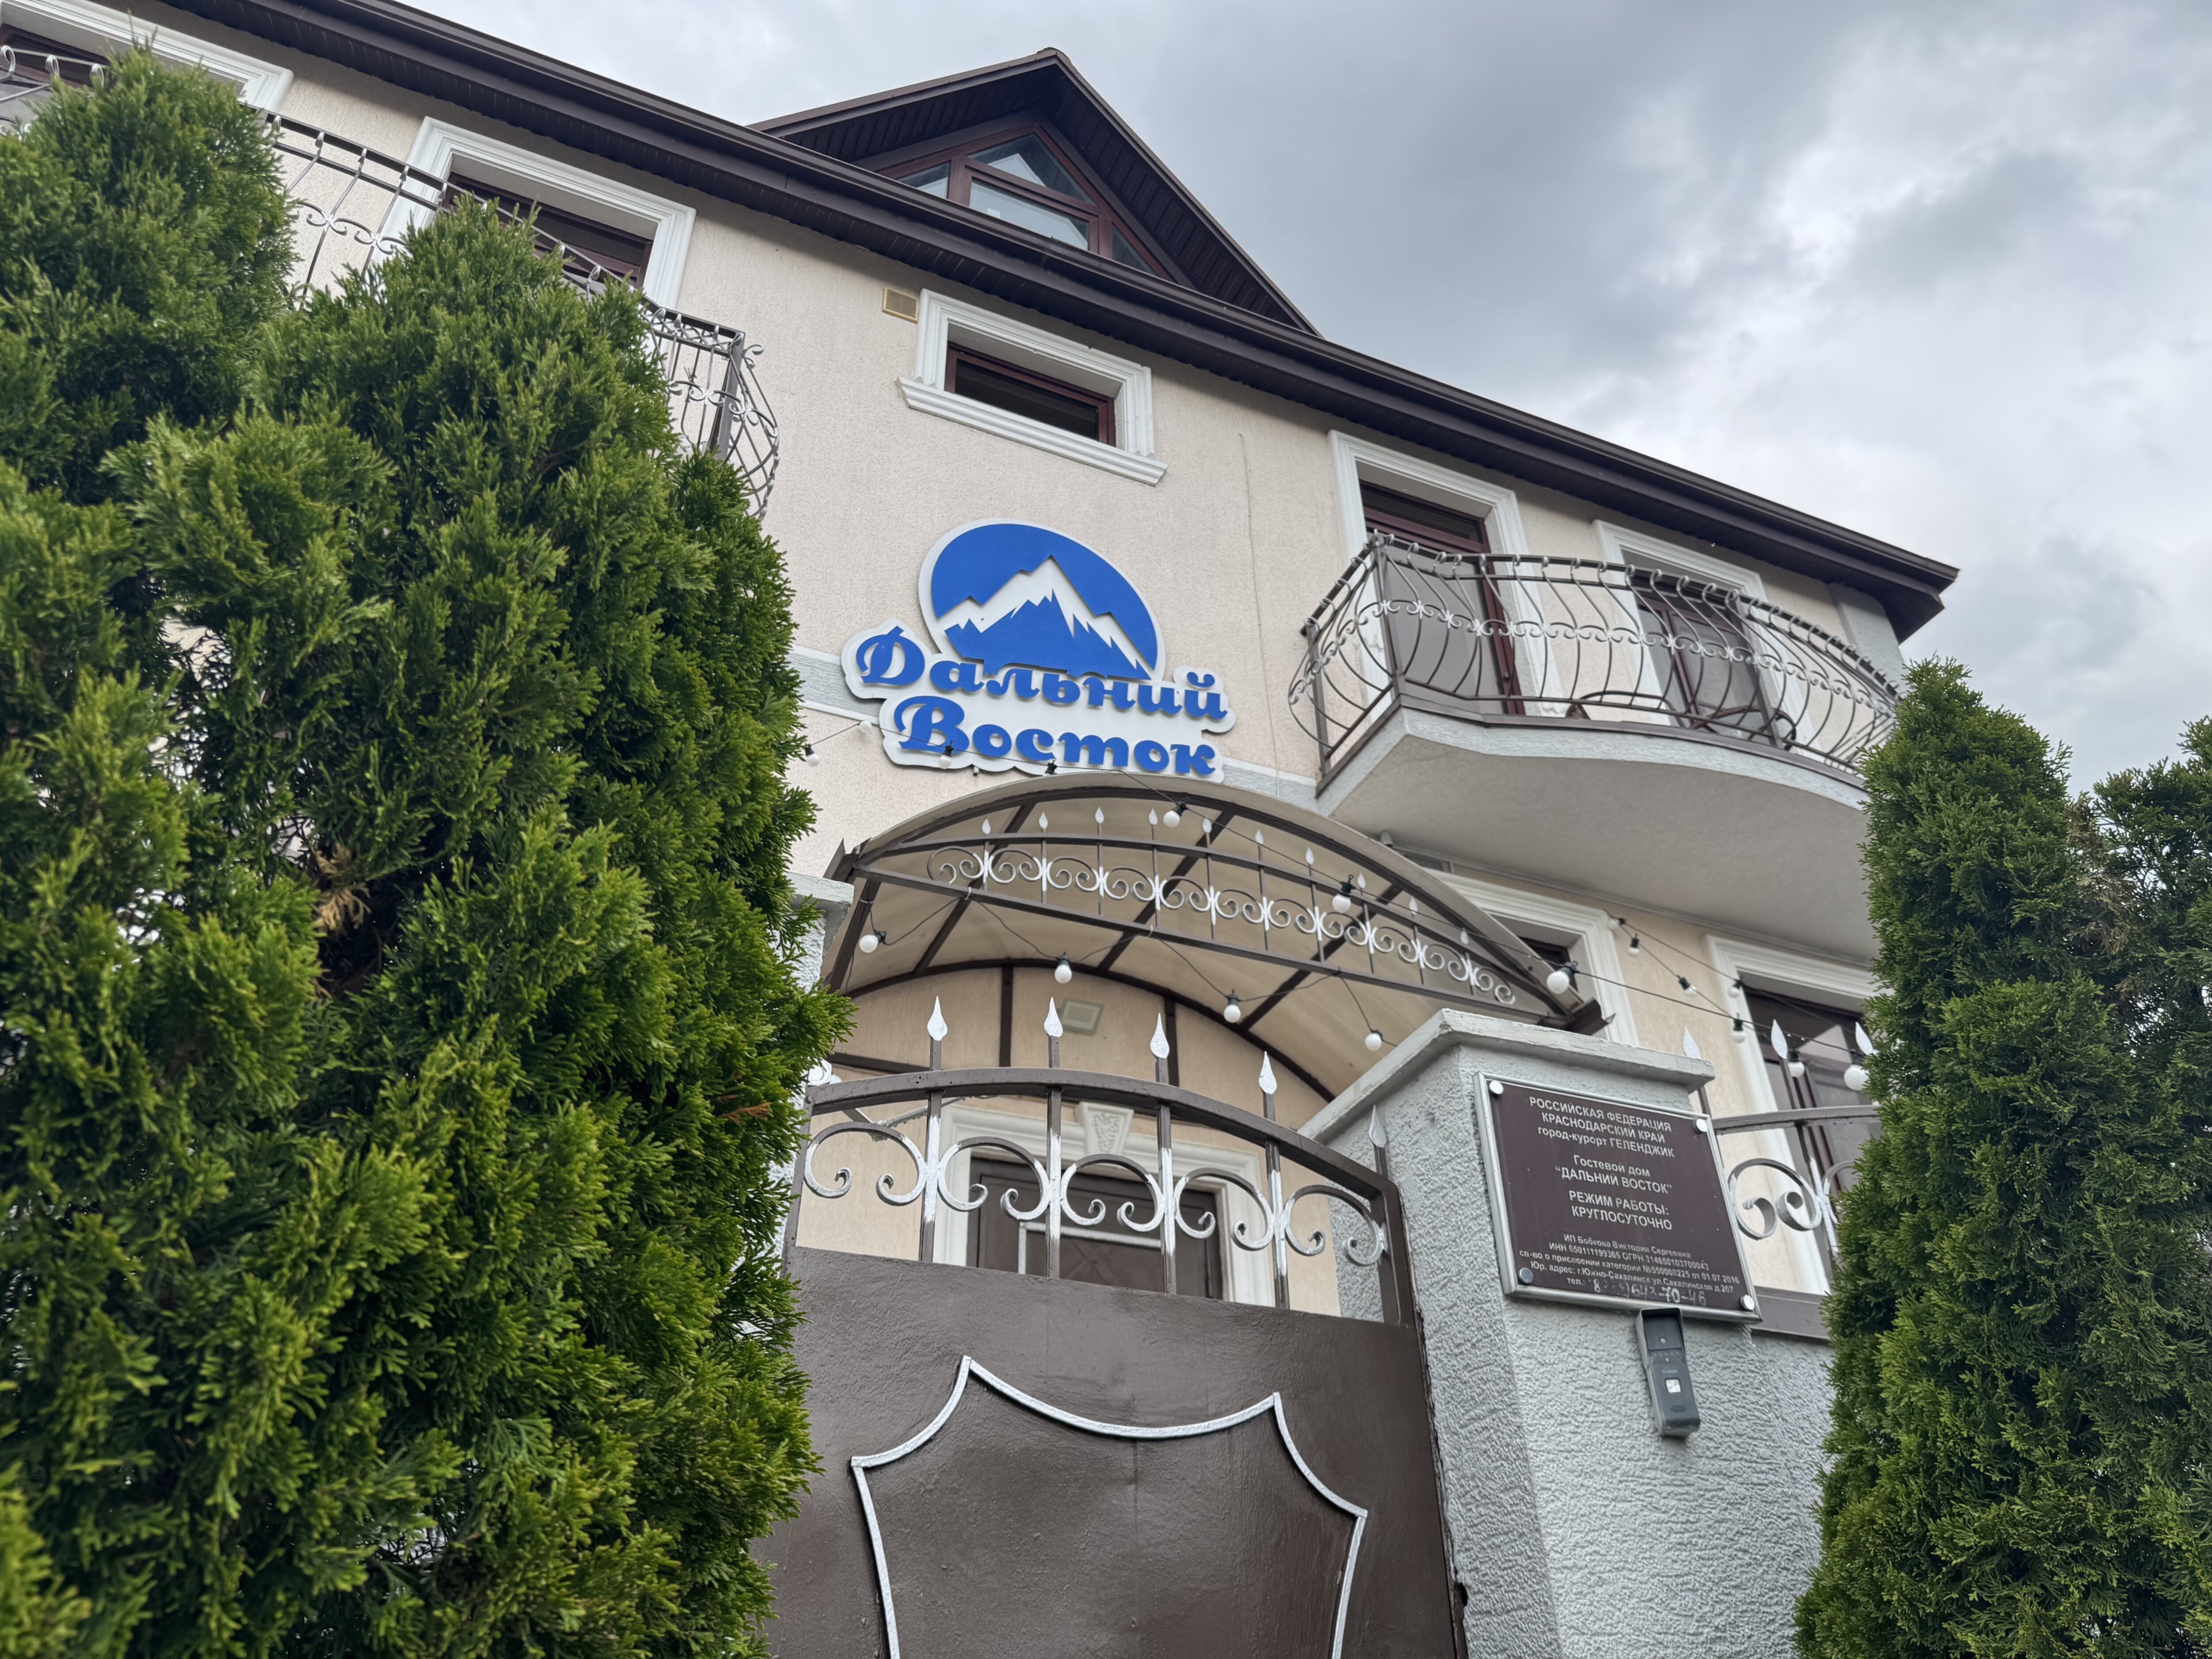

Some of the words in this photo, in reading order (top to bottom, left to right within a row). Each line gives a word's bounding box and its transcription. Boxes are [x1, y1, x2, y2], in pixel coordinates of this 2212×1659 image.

[856, 626, 1228, 720] Дальний
[894, 695, 1216, 776] Восток
[1529, 1097, 1604, 1119] РОССИЙСКАЯ
[1607, 1112, 1671, 1132] ФЕДЕРАЦИЯ
[1542, 1112, 1636, 1138] КРАСНОДАРСКИЙ
[1638, 1130, 1665, 1143] КРАЙ
[1538, 1127, 1607, 1147] город-курорт
[1610, 1138, 1675, 1158] ГЕЛЕНДЖИК
[1574, 1155, 1625, 1172] Гостевой
[1628, 1166, 1650, 1177] дом
[1569, 1190, 1613, 1207] РЕЖИМ
[1616, 1198, 1669, 1215] РАБОТЫ:
[1571, 1206, 1672, 1230] КРУГЛОСУТОЧНО
[1549, 1242, 1567, 1252] ИНН
[1569, 1244, 1621, 1259] 650111199365
[1622, 1252, 1644, 1262] ОГРН
[1645, 1255, 1709, 1271] 314650103700043
[1563, 1234, 1575, 1242] ИП
[1578, 1236, 1611, 1248] Бобкова
[1612, 1241, 1649, 1253] Виктория
[1651, 1246, 1691, 1258] Сергеевна
[1520, 1250, 1543, 1259] св-во
[1552, 1255, 1600, 1266] присвоении
[1602, 1261, 1641, 1272] категории
[1531, 1260, 1547, 1271] Юр.
[1549, 1264, 1575, 1274] адрес:
